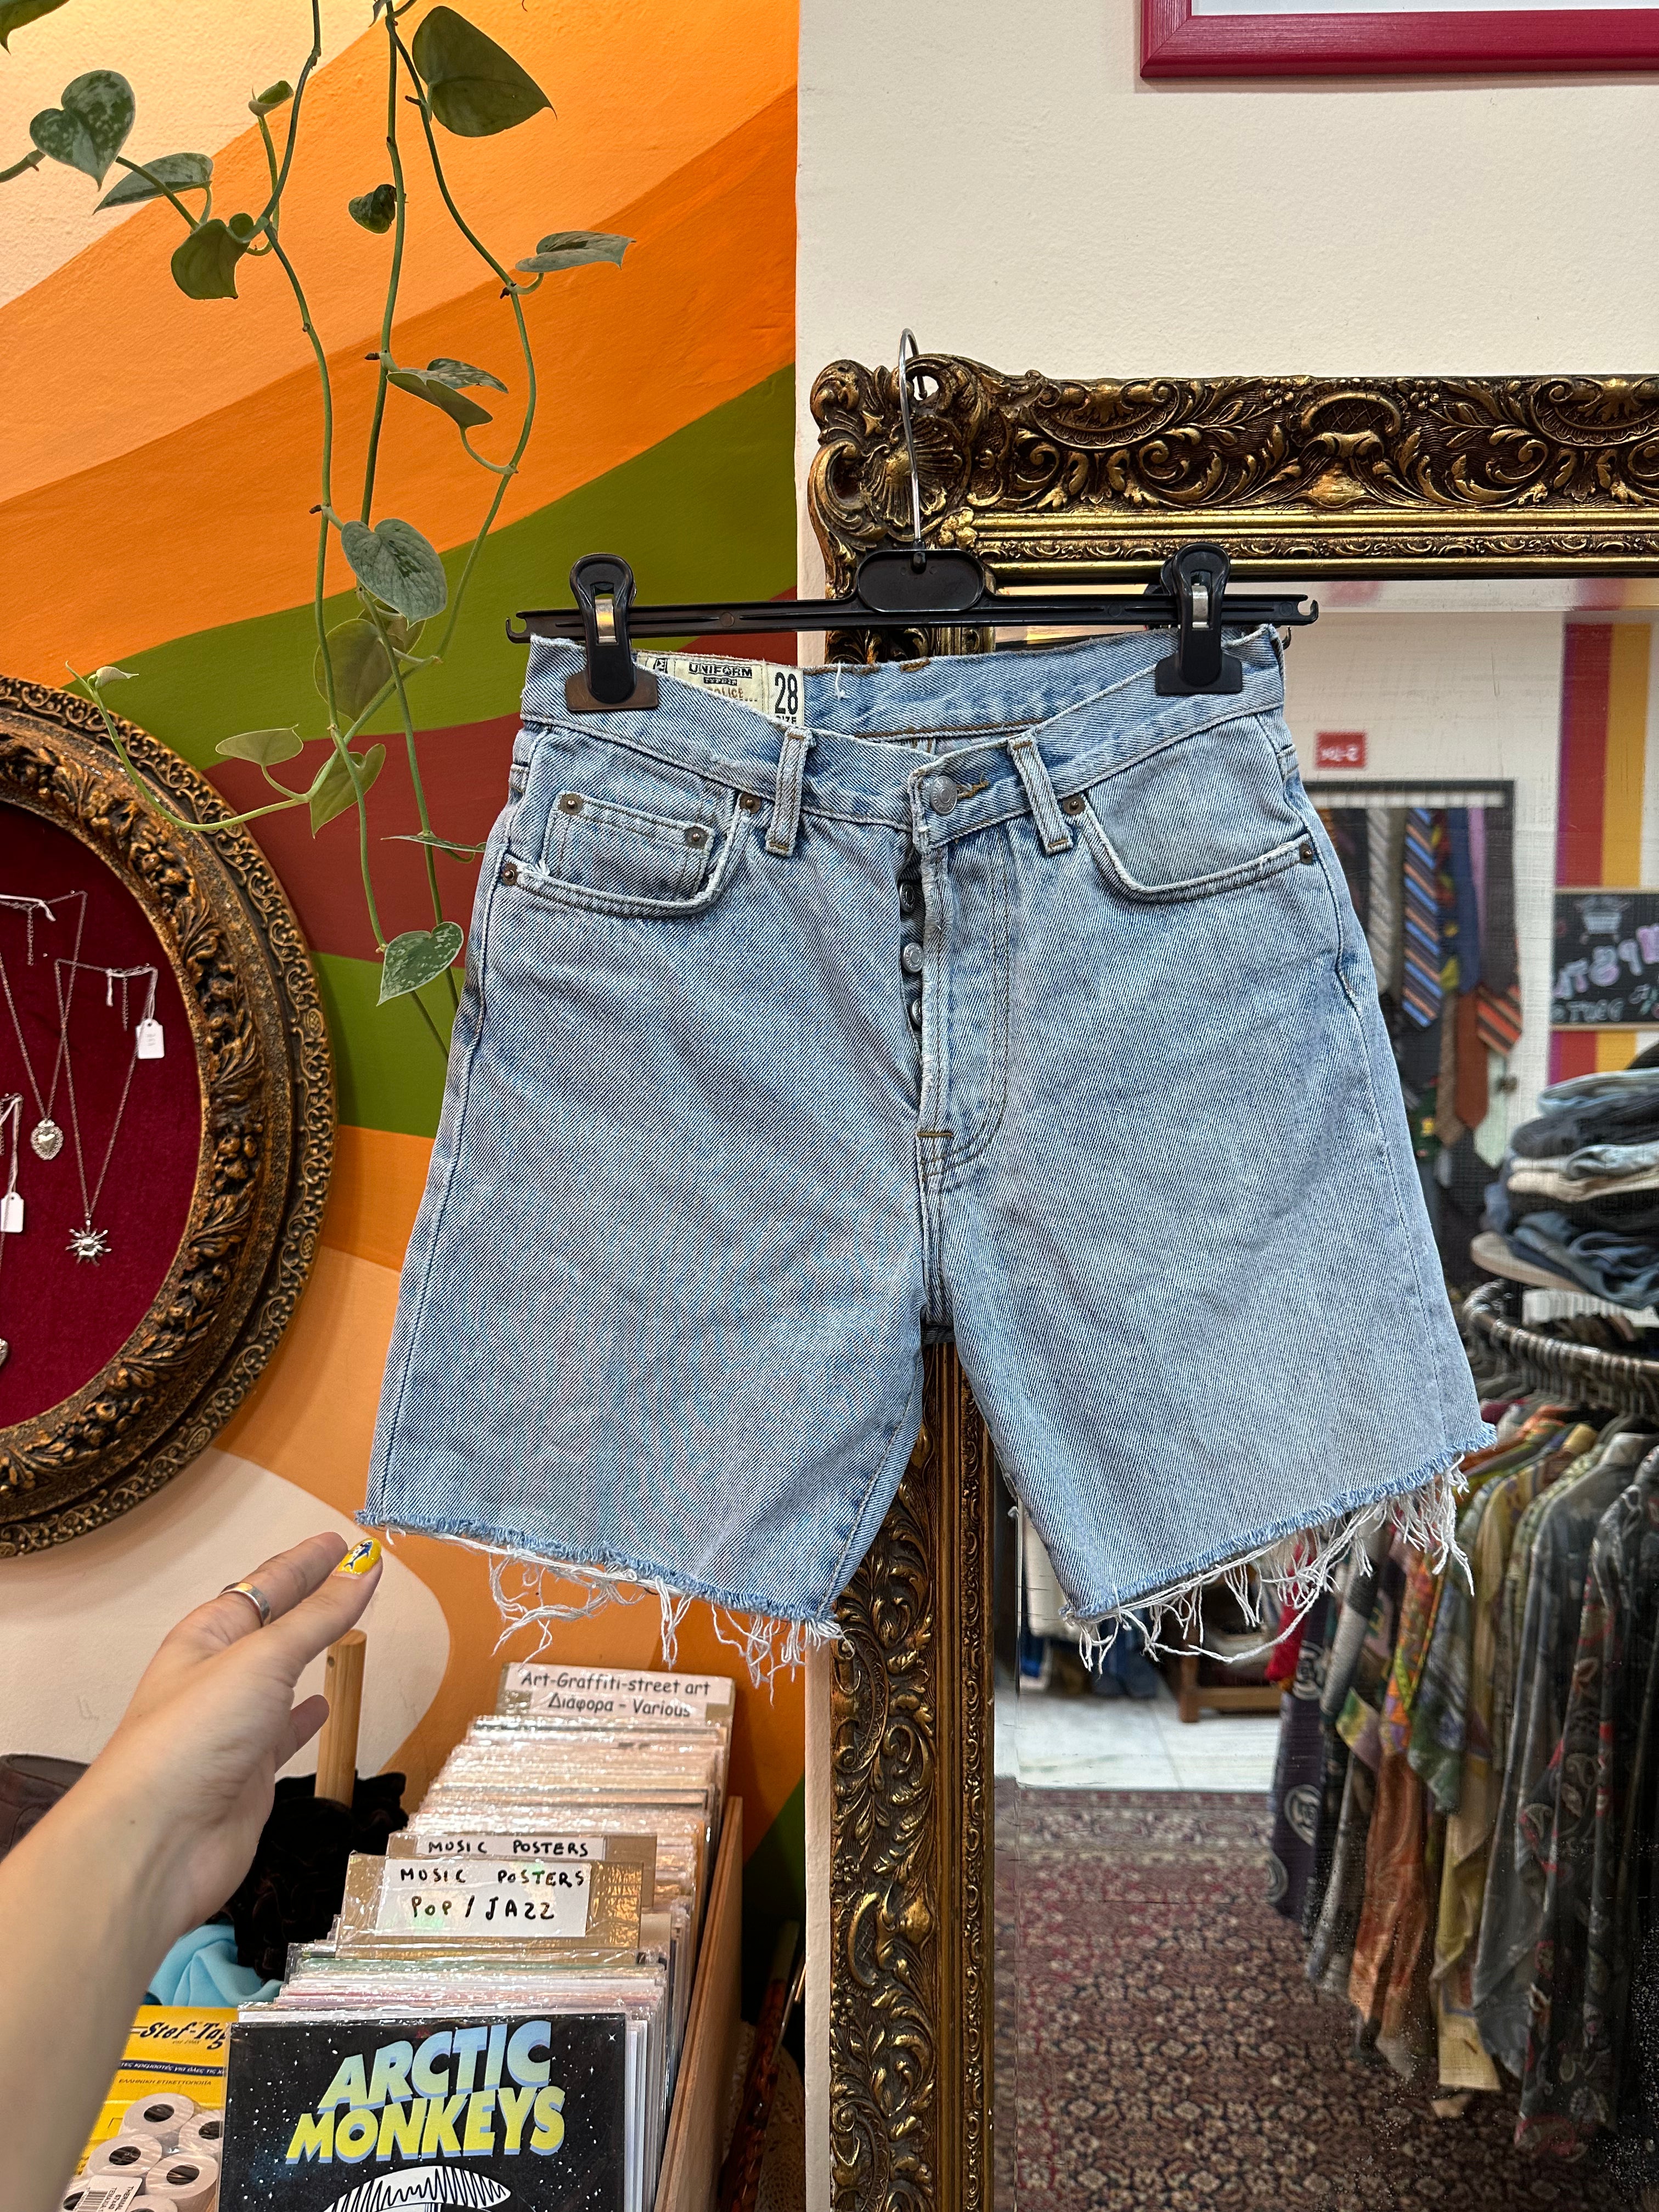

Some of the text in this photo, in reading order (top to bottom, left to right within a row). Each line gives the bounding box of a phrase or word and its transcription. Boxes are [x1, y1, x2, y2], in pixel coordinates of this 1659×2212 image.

[689, 663, 752, 678] UNIFORM
[775, 672, 798, 715] 28
[685, 1683, 711, 1696] art
[548, 1692, 613, 1715] Διάφορα
[633, 1698, 691, 1718] Various
[513, 1839, 588, 1857] POSTERS
[400, 1868, 584, 1887] MUSIC POSTERS
[317, 2021, 551, 2114] ARCTIC
[285, 2086, 566, 2164] MONKEYS
[115, 2186, 134, 2211] THERMAL
